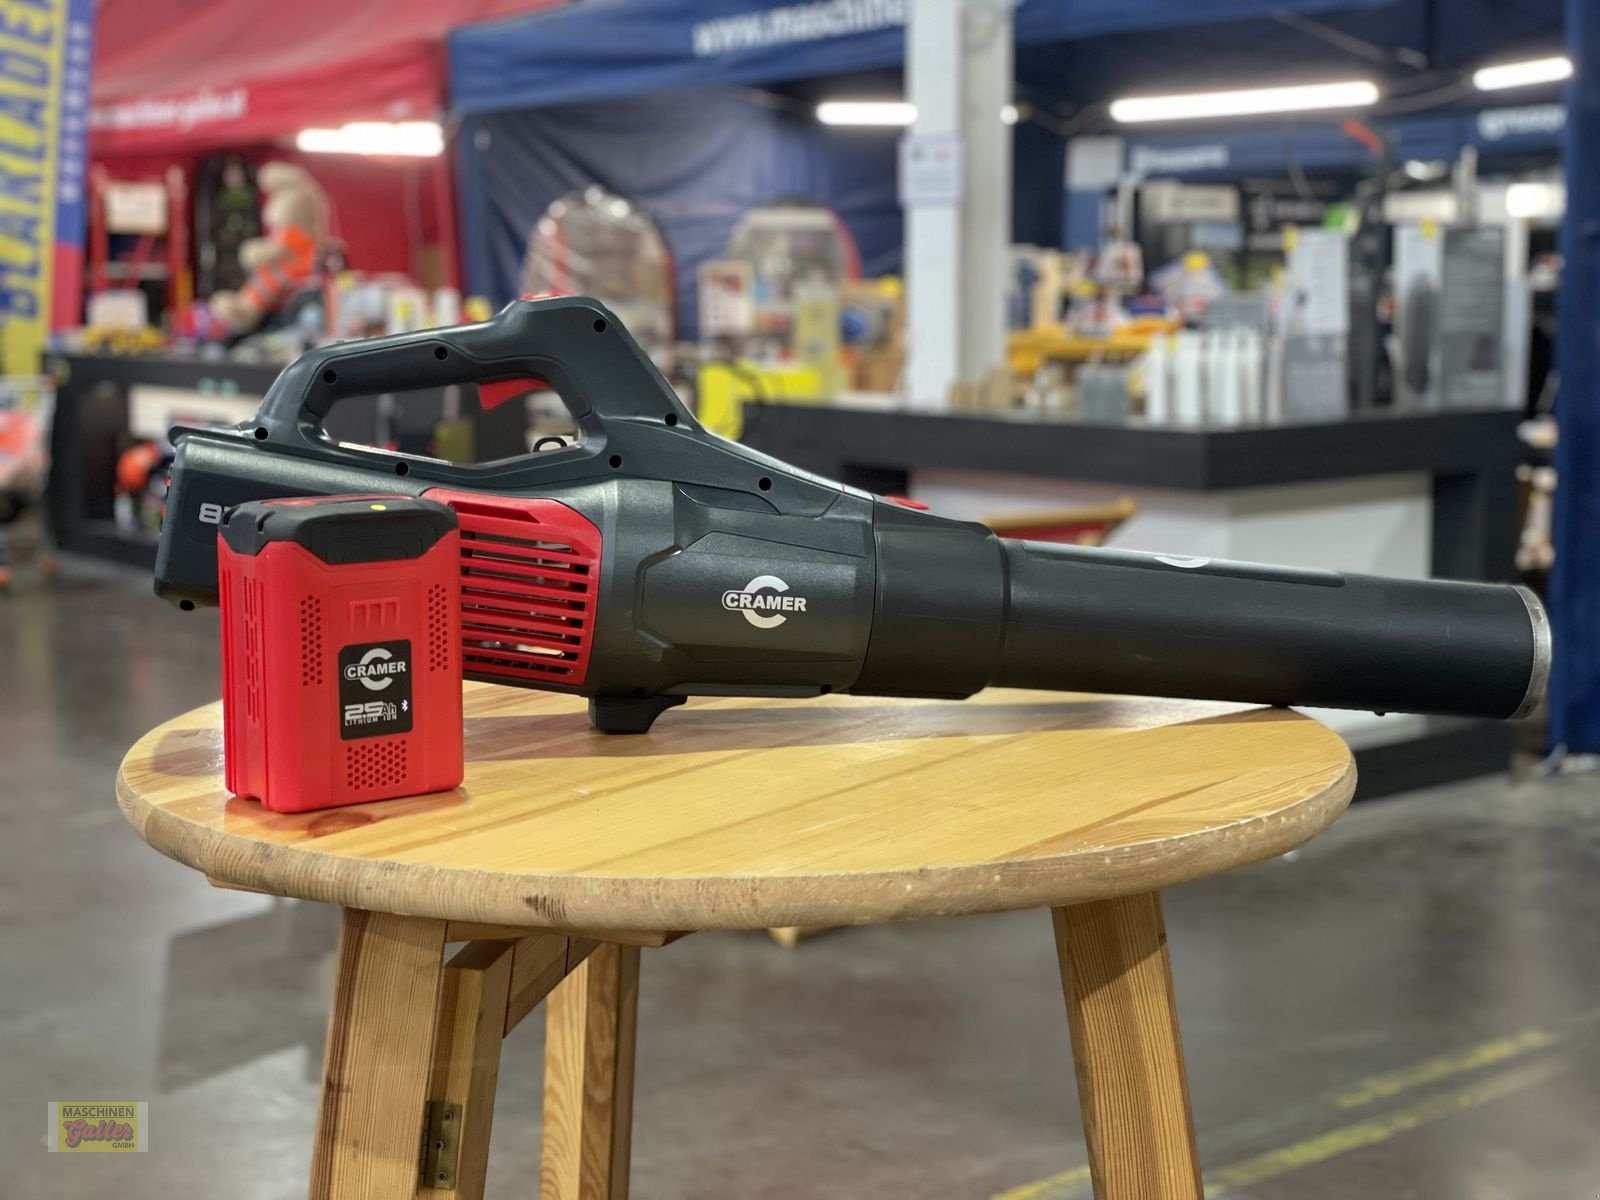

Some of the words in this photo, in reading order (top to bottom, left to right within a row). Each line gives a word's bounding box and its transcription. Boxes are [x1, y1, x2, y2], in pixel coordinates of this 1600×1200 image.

[199, 502, 232, 524] 8
[725, 592, 807, 612] CRAMER
[346, 660, 407, 678] CRAMER
[344, 716, 379, 727] LITHIUM
[383, 714, 398, 722] ION
